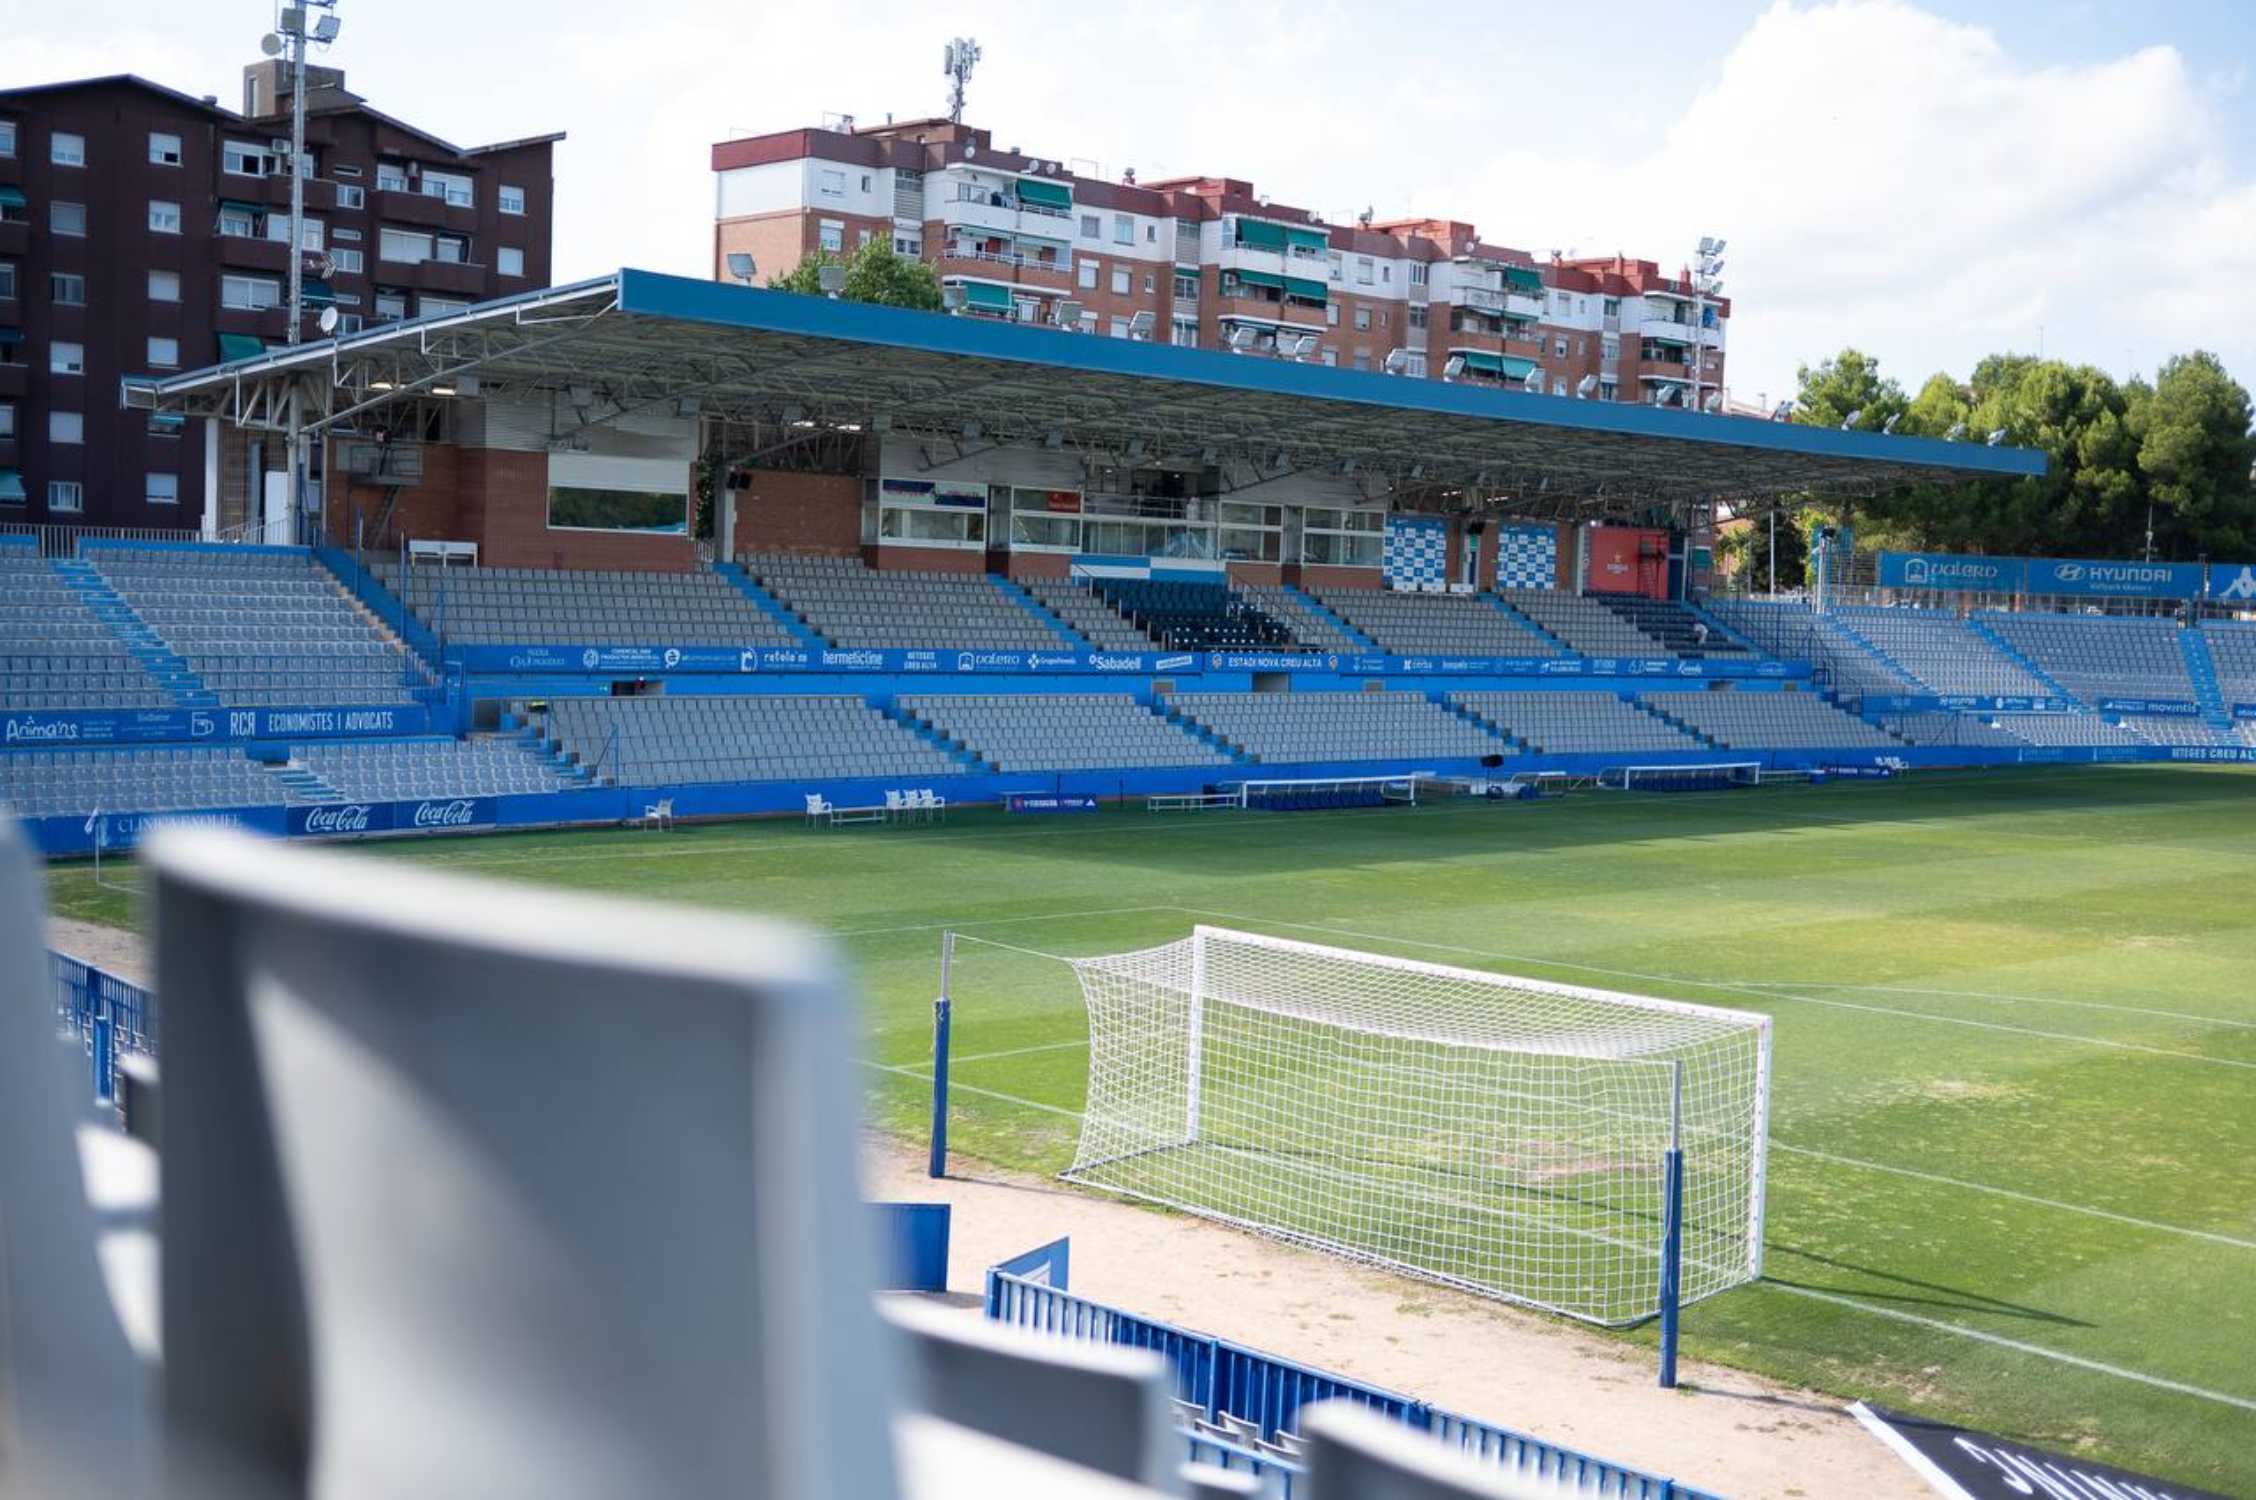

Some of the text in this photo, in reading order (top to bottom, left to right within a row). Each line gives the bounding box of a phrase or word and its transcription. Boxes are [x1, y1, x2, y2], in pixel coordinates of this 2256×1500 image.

[2089, 567, 2173, 583] HYUNDAI
[1096, 655, 1142, 670] Sabadell
[1227, 656, 1256, 668] ESTADI
[1257, 656, 1279, 668] NOVA
[268, 712, 333, 732] ECONOMISTES
[345, 711, 394, 730] ADVOCATS
[2239, 749, 2256, 761] AL
